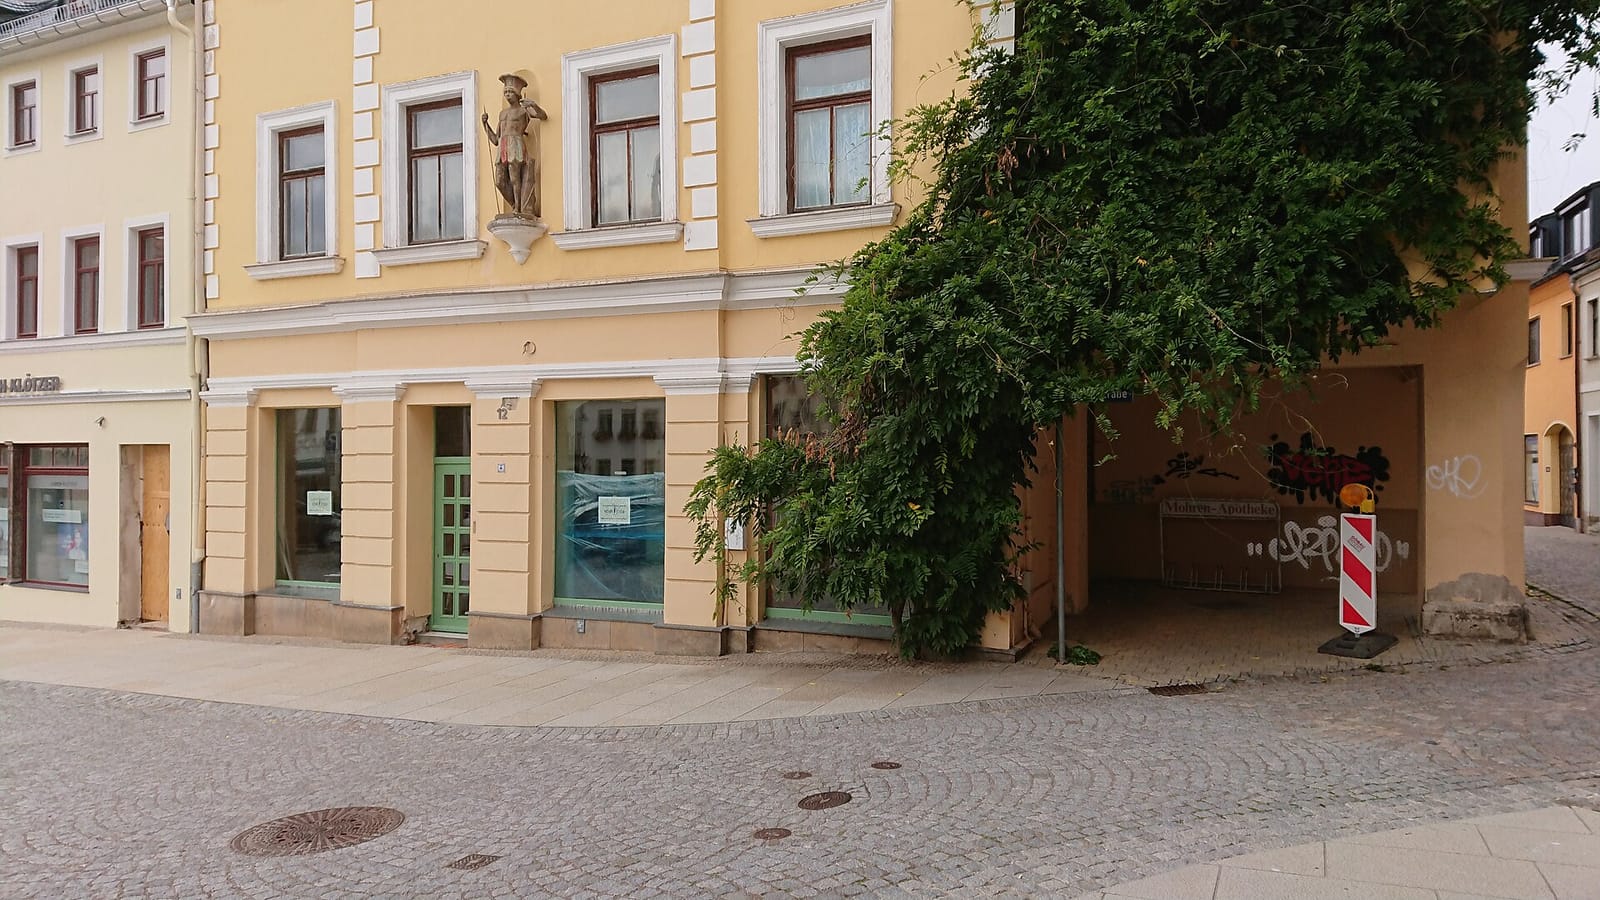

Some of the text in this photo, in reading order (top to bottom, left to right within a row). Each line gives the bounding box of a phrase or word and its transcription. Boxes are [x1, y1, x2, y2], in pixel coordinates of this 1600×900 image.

[10, 373, 60, 392] KLÖTZER
[497, 408, 508, 420] 12
[1166, 501, 1275, 515] Mohren-Apotheke
